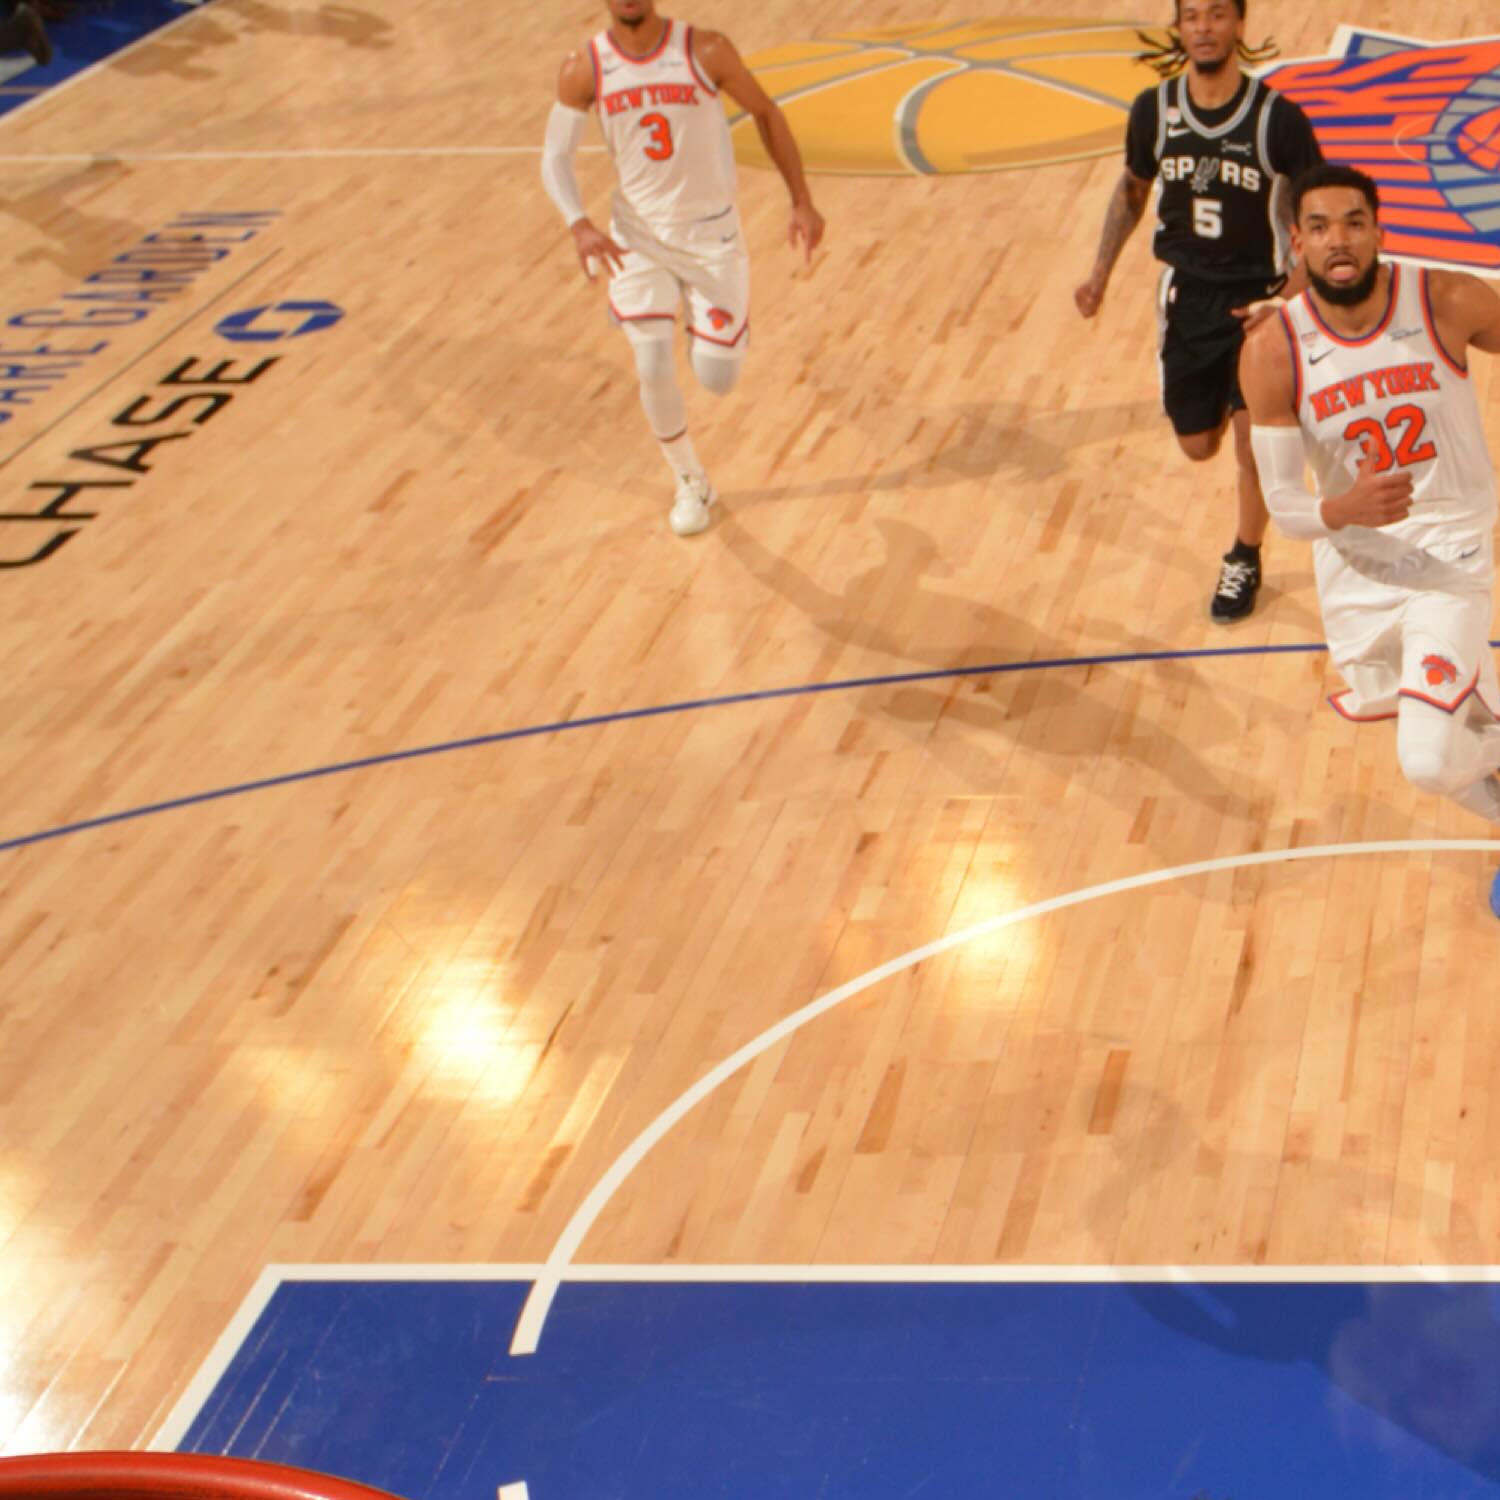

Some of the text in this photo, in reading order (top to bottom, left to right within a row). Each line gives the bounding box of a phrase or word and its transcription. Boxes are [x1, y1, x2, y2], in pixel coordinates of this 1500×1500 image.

[603, 83, 699, 117] NEW YORK
[639, 111, 674, 161] 3
[1192, 198, 1223, 239] 5
[1308, 361, 1441, 423] NEW YORK
[1343, 402, 1438, 474] 32
